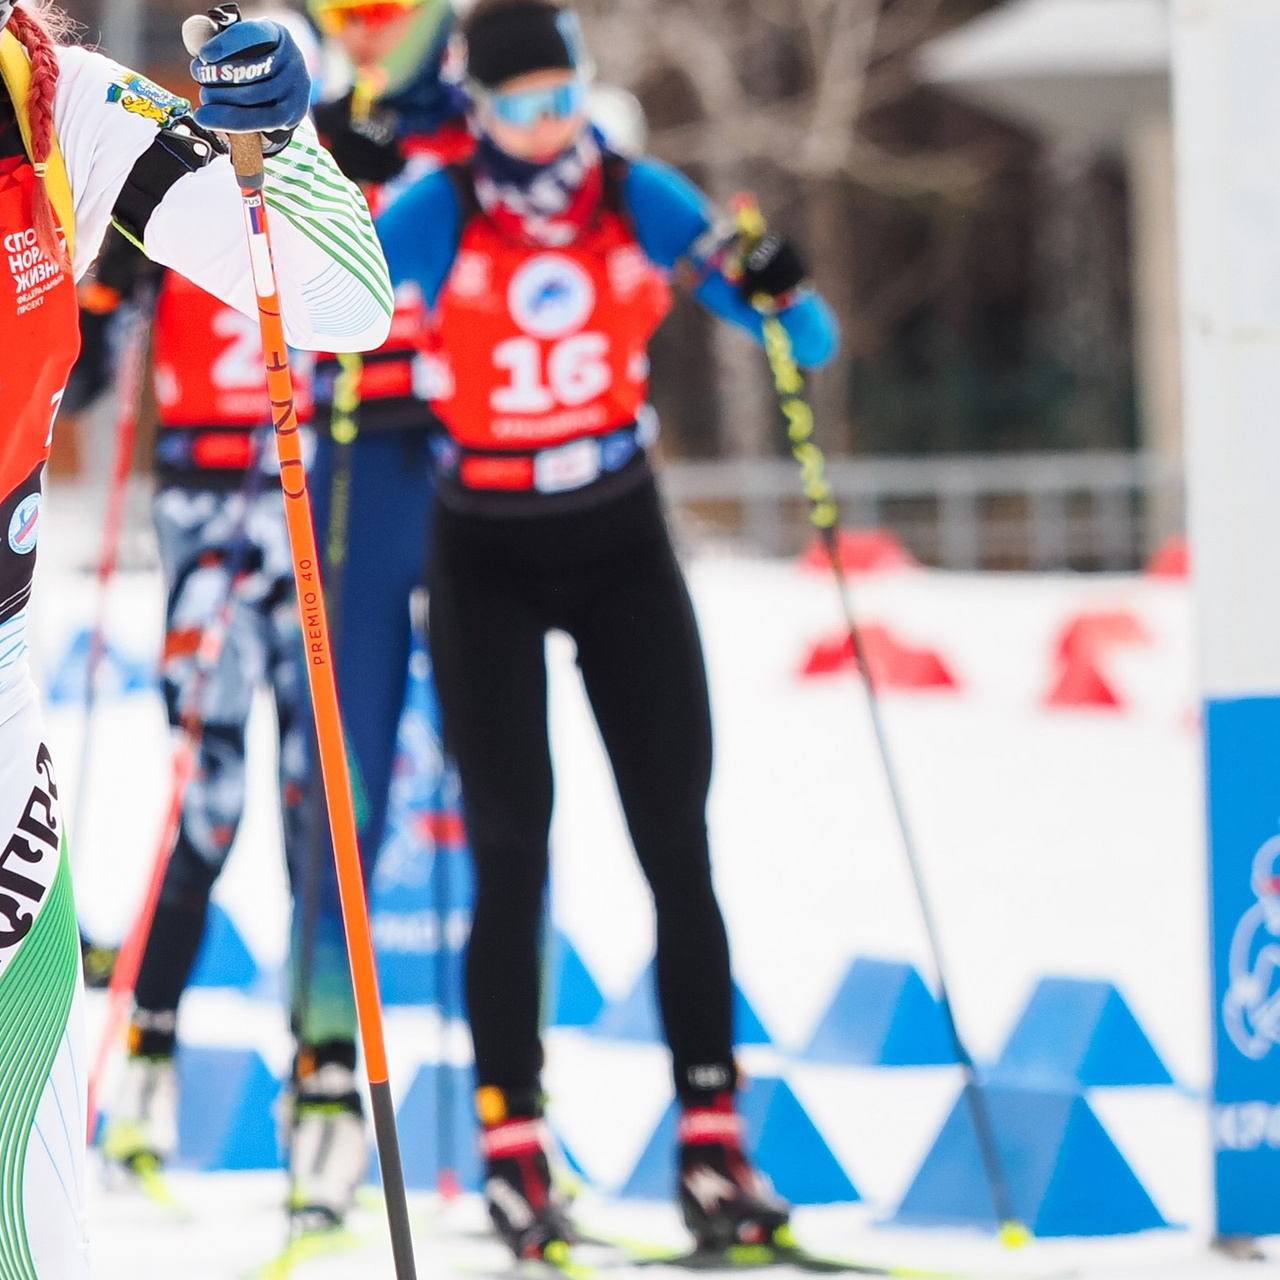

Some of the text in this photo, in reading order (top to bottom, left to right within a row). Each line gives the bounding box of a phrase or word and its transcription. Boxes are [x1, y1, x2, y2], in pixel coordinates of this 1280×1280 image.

[17, 296, 44, 316] ПРОЕКТ
[490, 331, 613, 413] 16
[299, 559, 325, 665] PREMIO 40
